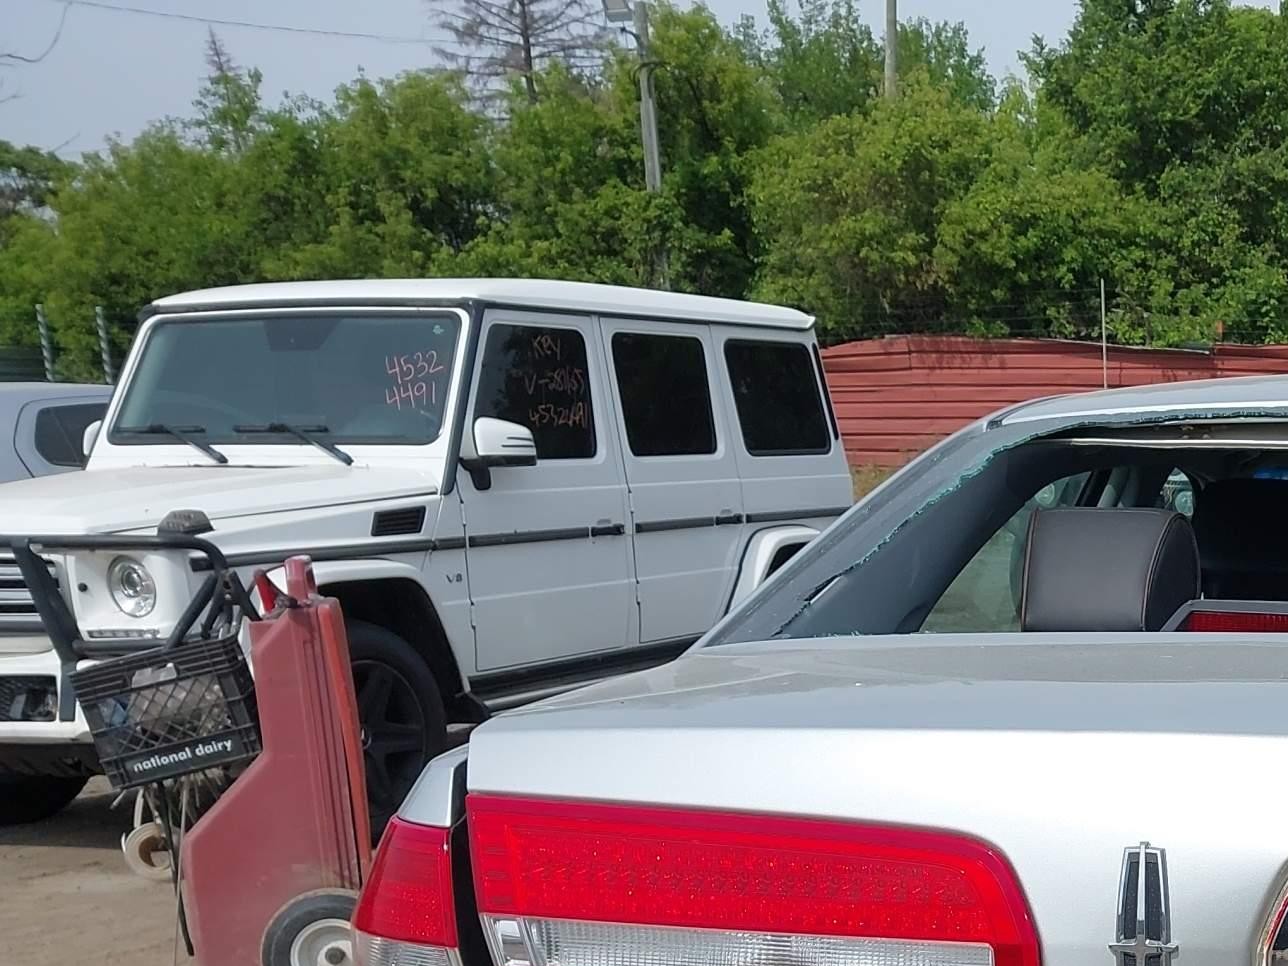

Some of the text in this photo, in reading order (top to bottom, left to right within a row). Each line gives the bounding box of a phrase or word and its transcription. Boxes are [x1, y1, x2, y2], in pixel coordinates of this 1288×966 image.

[384, 350, 444, 385] 4532
[385, 381, 437, 411] 4491
[133, 739, 233, 772] national dairy
